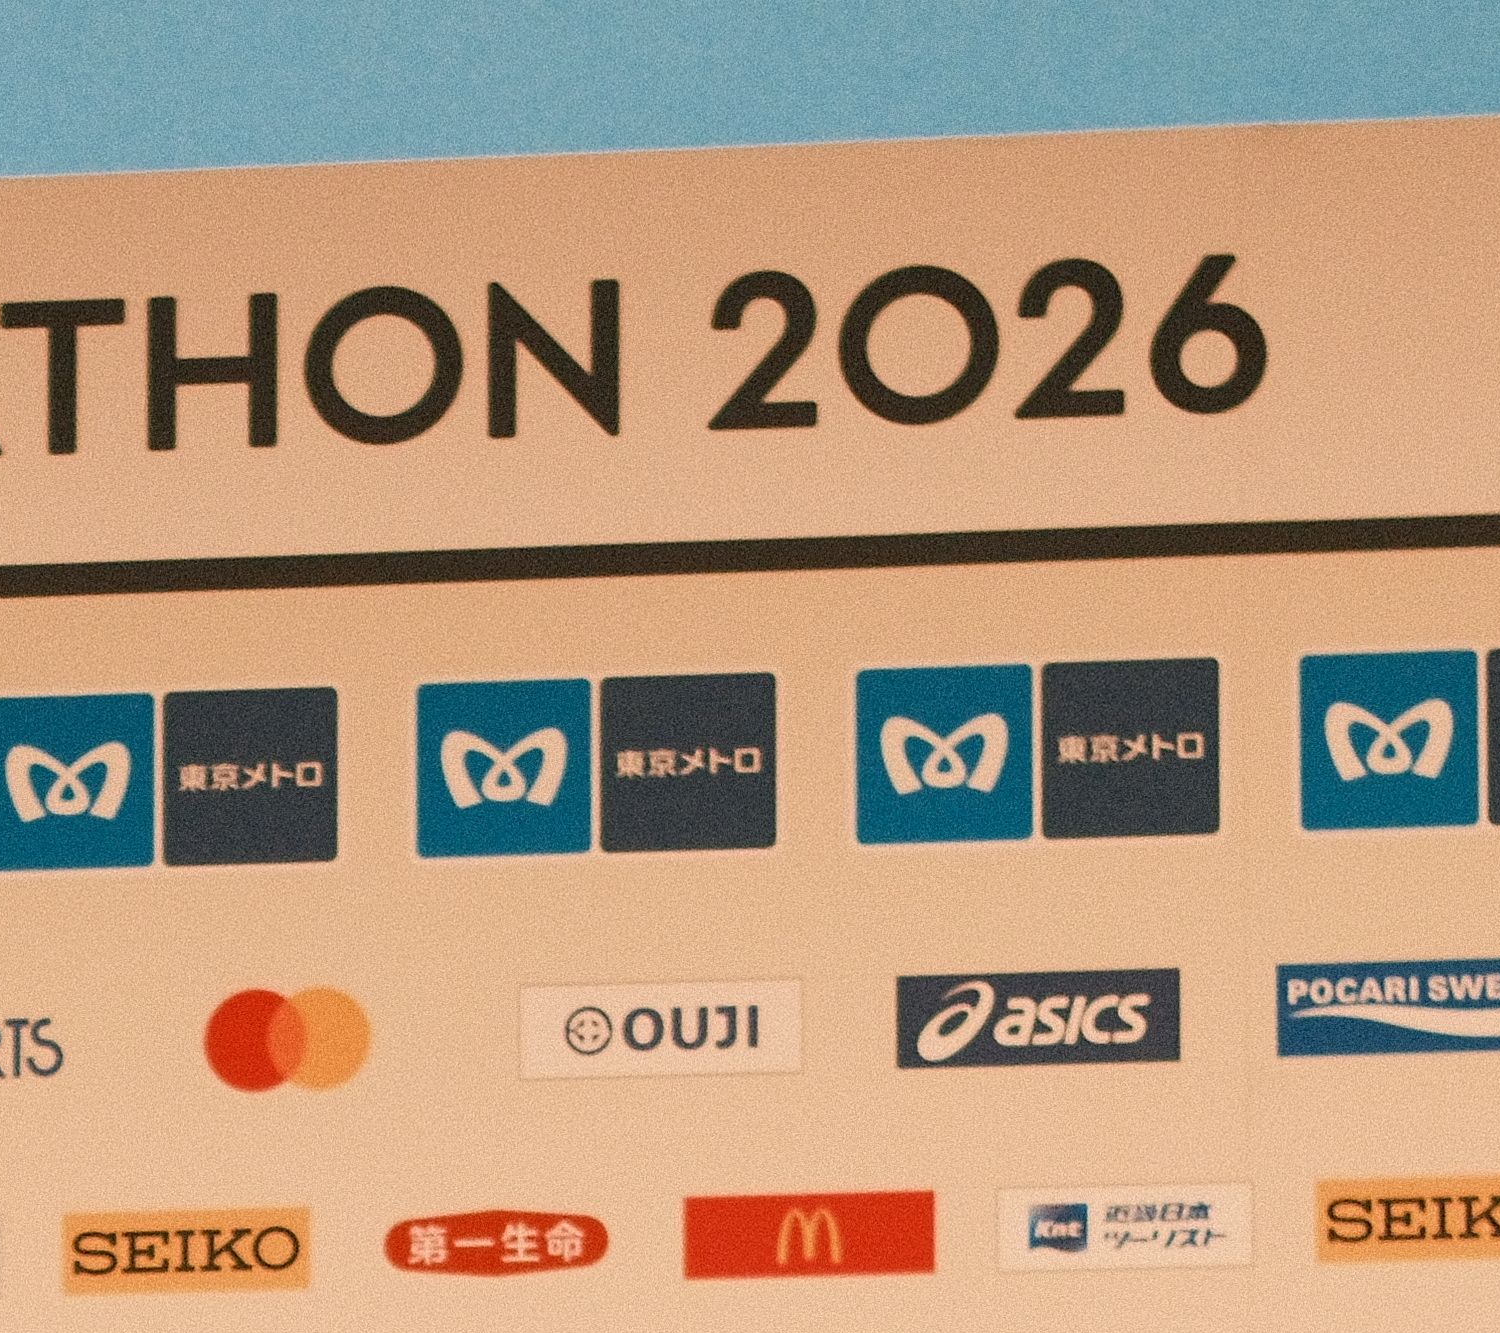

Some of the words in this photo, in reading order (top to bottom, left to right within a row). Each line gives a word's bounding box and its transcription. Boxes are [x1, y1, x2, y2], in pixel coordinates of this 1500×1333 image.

[708, 254, 1267, 431] 2026
[618, 748, 761, 776] 東京メトロ
[1288, 977, 1423, 1006] POCARI
[623, 1005, 758, 1051] OUJI
[994, 994, 1149, 1046] asics
[73, 1226, 300, 1276] SEIKO
[409, 1221, 584, 1265] 第一生命
